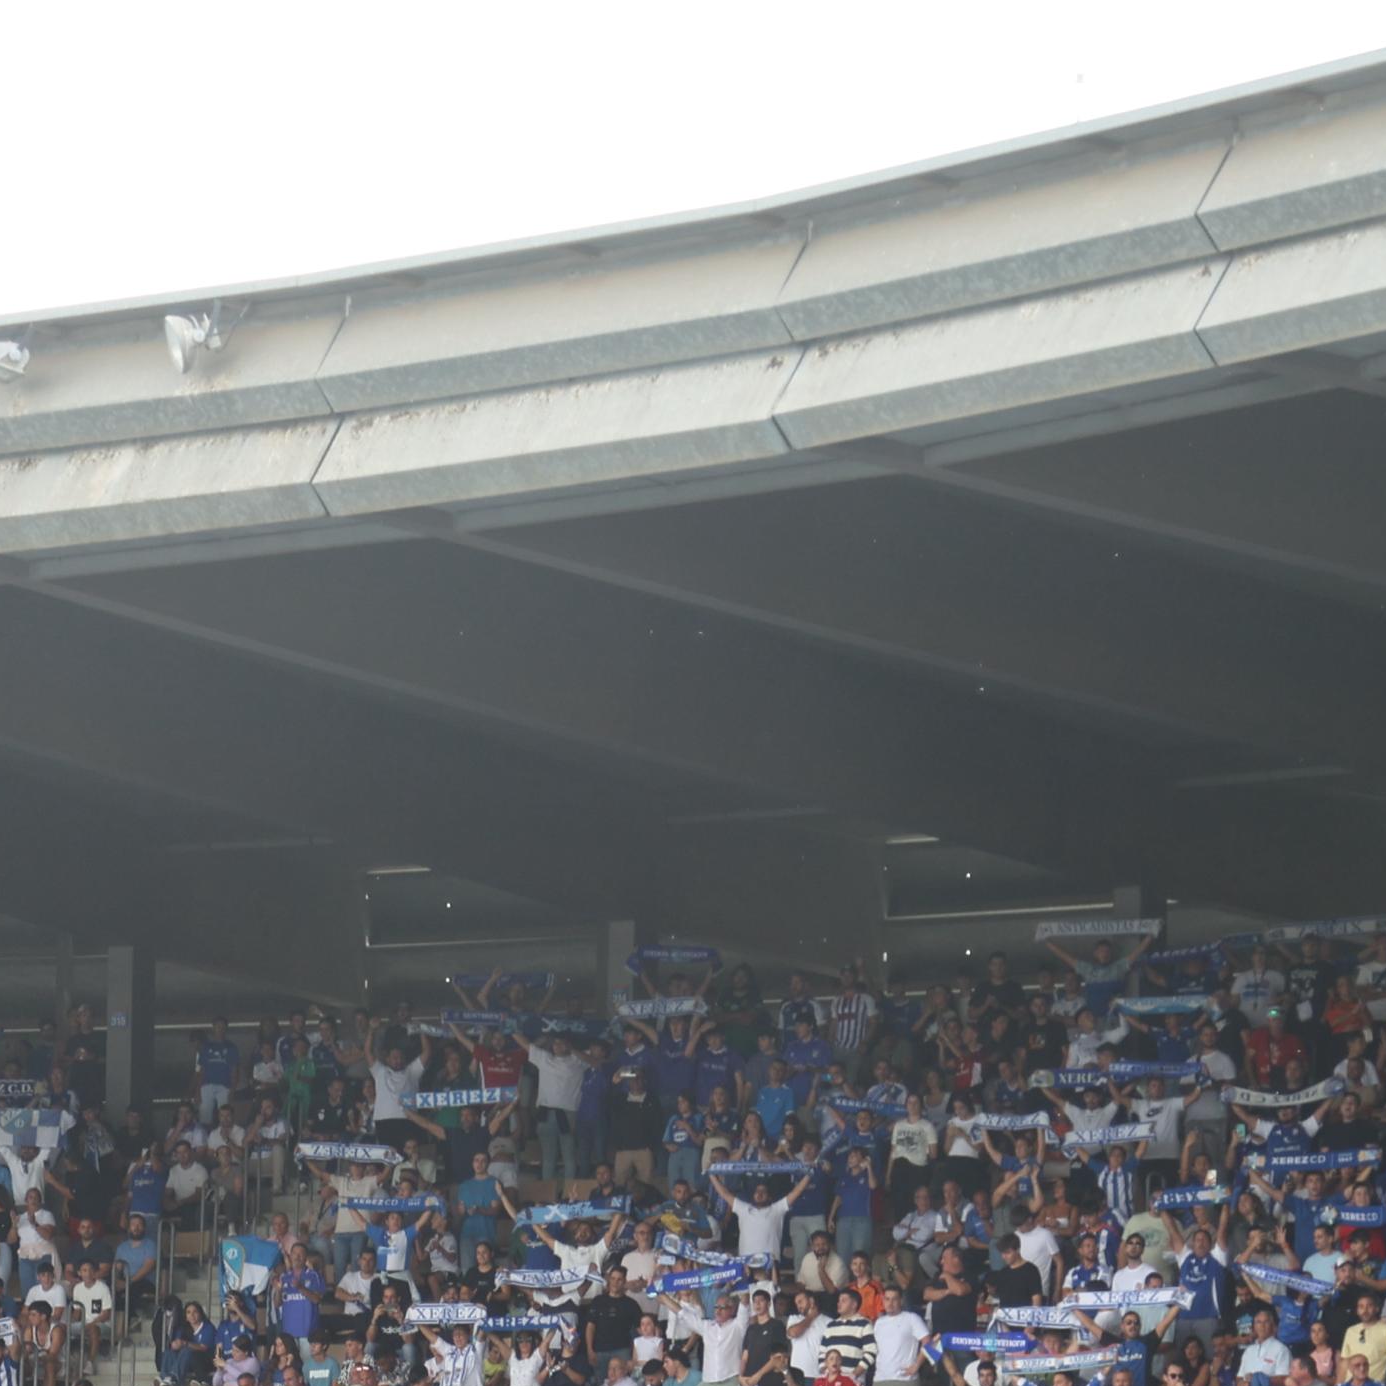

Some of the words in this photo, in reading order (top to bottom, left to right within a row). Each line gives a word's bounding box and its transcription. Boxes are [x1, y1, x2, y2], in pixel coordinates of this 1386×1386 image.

[416, 1088, 497, 1107] XEREZ
[1077, 1126, 1137, 1141] XEREZ
[1094, 1290, 1158, 1303] XEREZ
[416, 1307, 477, 1319] XEREZ
[1002, 1307, 1074, 1322] XEREZ
